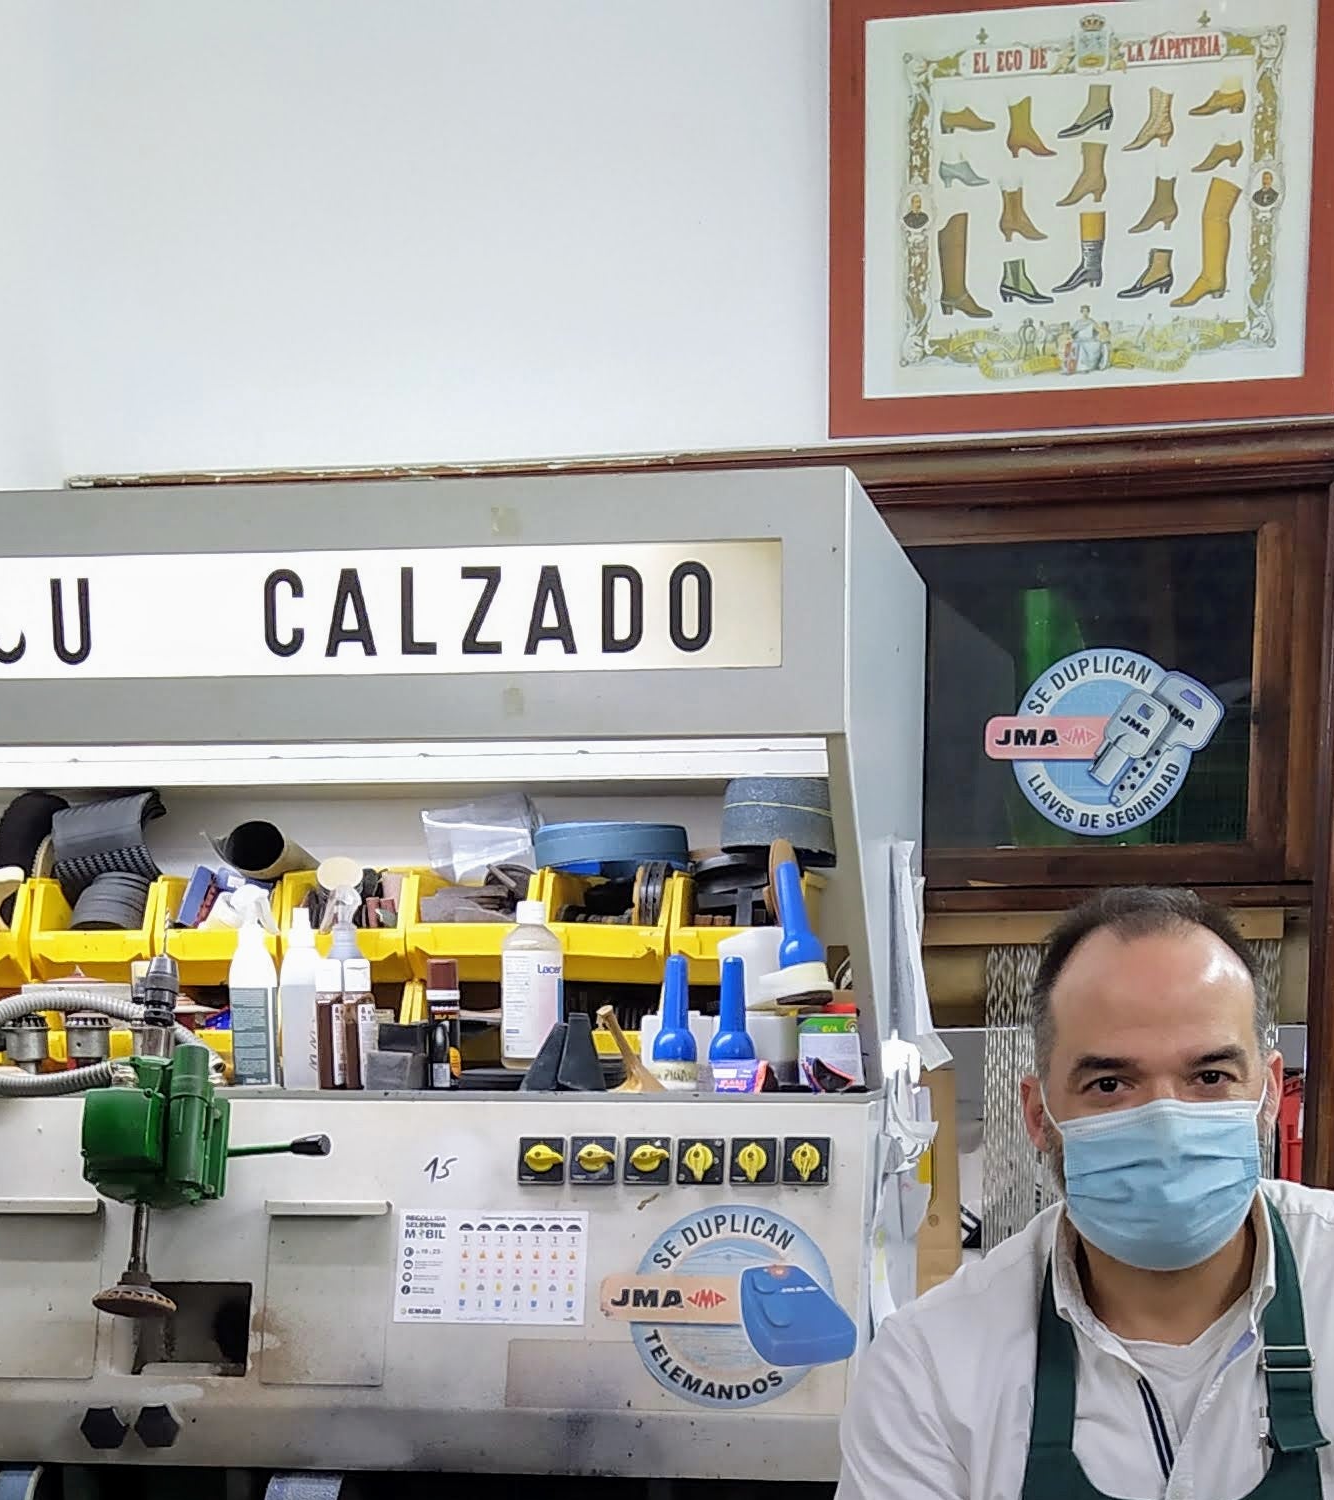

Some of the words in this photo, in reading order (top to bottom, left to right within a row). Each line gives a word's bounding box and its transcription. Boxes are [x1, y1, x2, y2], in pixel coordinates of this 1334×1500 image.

[973, 52, 990, 75] EL
[997, 50, 1023, 72] ECO
[1030, 48, 1048, 70] DE
[1127, 42, 1144, 63] LA
[1148, 34, 1222, 61] ZAPATERIA
[264, 559, 713, 658] CALZADO
[1027, 687, 1052, 716] SE
[1050, 655, 1153, 692] DUPLICAN
[995, 728, 1060, 747] JMA
[1119, 714, 1152, 740] JMA
[1028, 772, 1075, 825] LLAVES
[1078, 813, 1100, 829] DE
[1105, 761, 1181, 830] SEGURIDAD
[423, 1156, 458, 1183] 15
[653, 1238, 683, 1270] SE
[682, 1213, 796, 1252] DUPLICAN
[610, 1287, 685, 1309] JMA
[644, 1328, 785, 1402] TELEMANDOS
